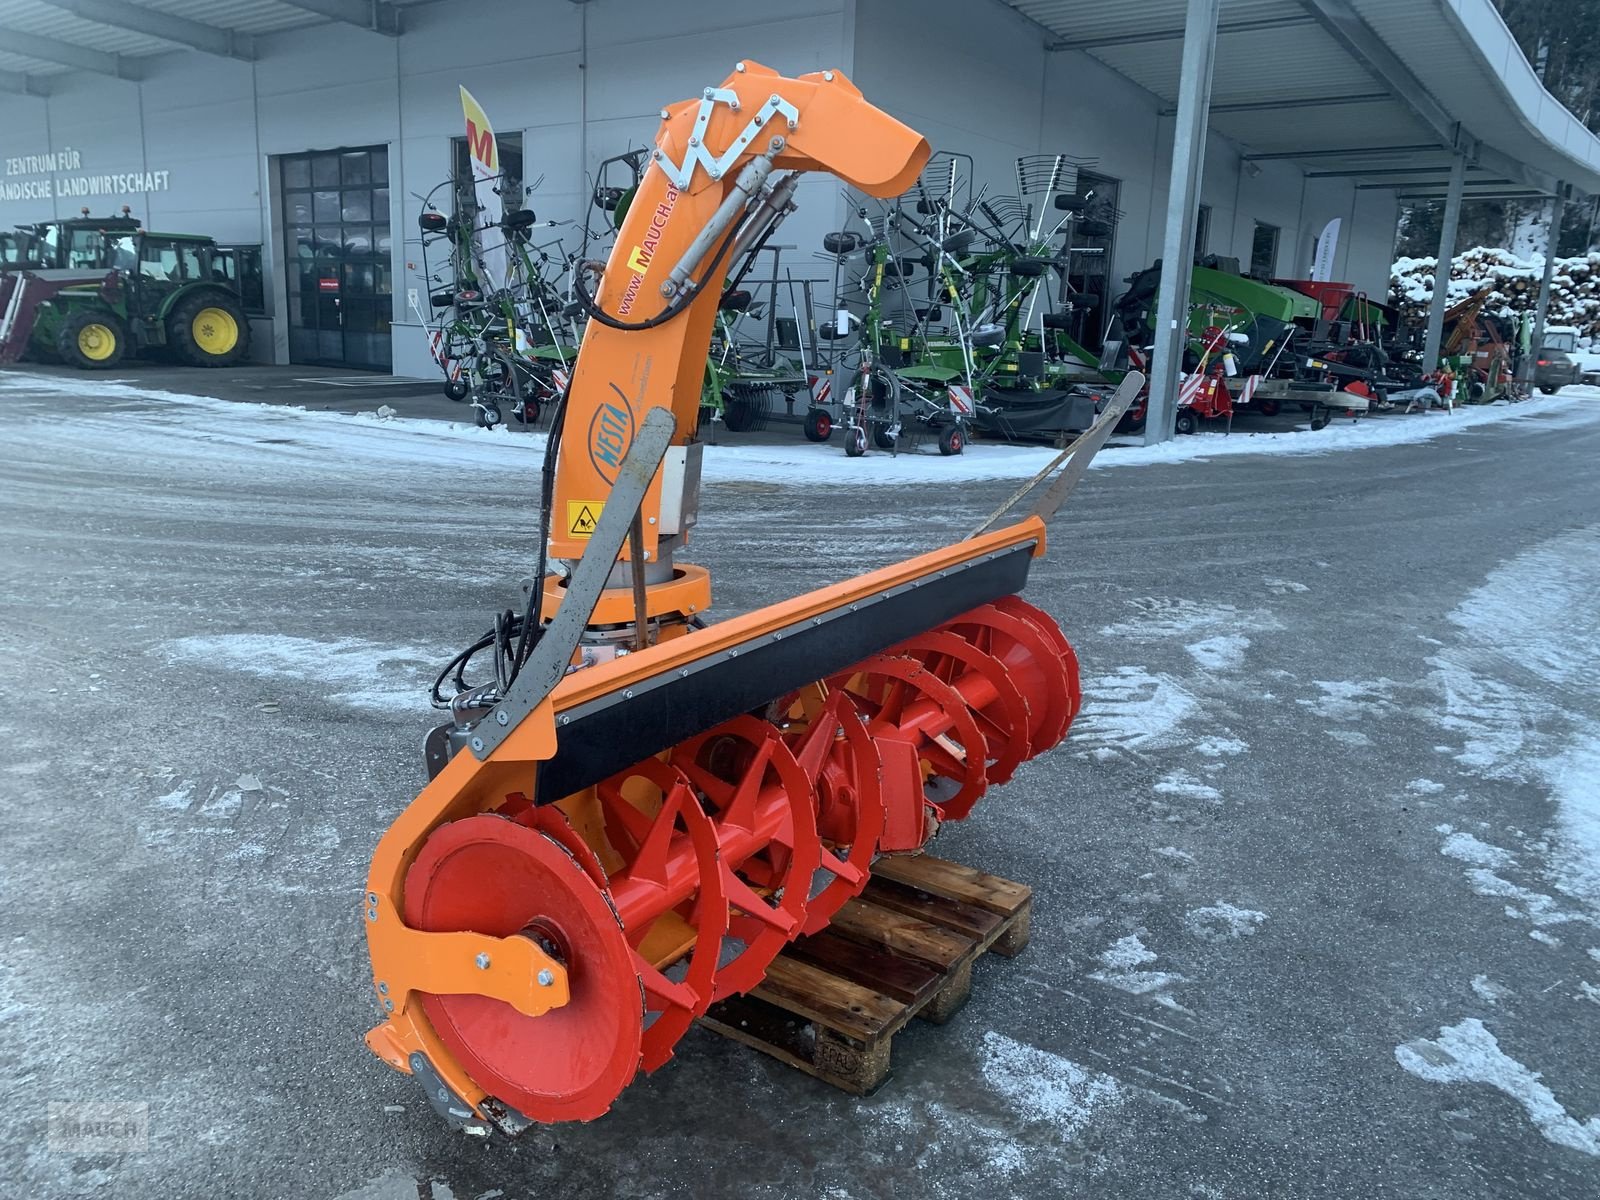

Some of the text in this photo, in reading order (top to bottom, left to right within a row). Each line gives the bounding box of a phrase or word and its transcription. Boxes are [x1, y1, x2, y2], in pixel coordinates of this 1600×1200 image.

[467, 118, 493, 168] M
[6, 147, 81, 176] ZENTRUM FÜR
[56, 170, 169, 197] LANDWIRTSCHAFT
